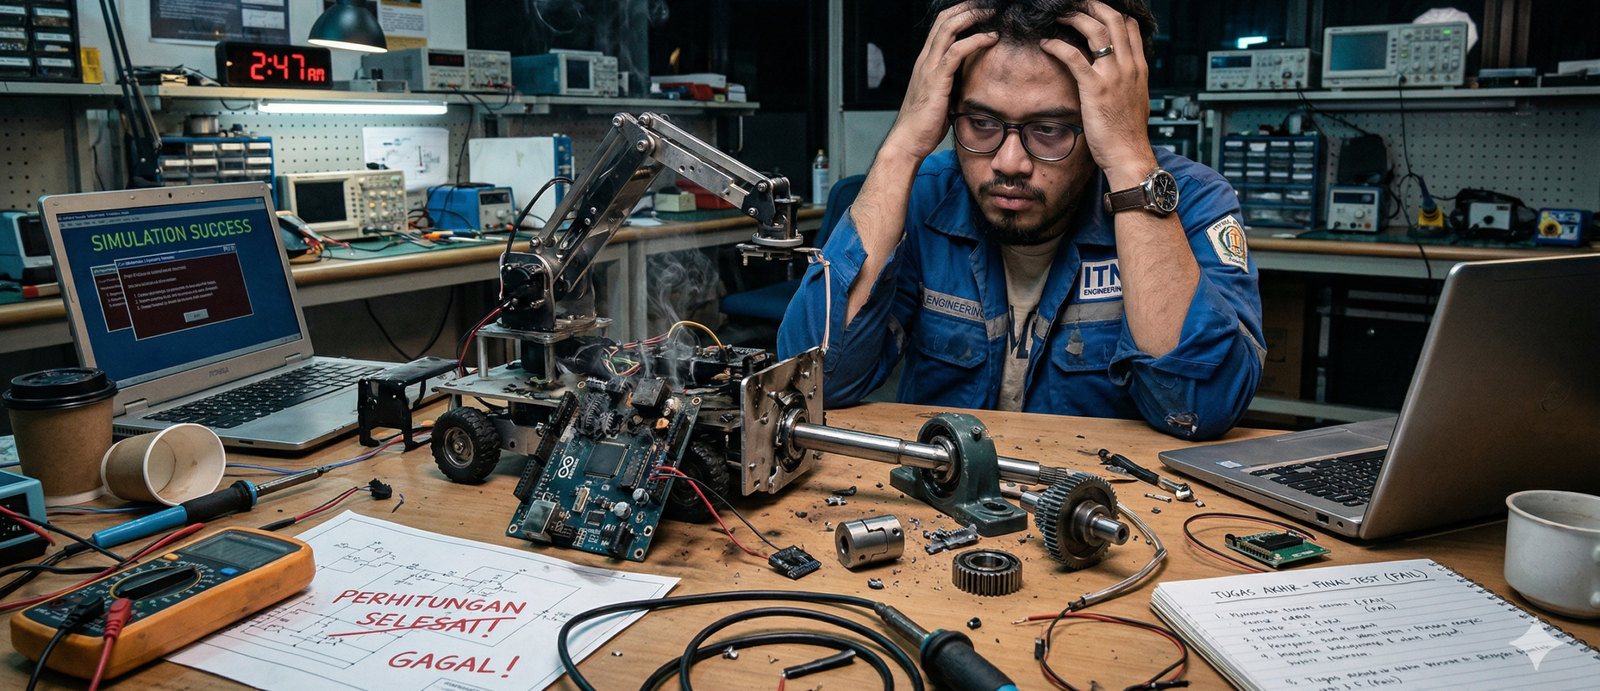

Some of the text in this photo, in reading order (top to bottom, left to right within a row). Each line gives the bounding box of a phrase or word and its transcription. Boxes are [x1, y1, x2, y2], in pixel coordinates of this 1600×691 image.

[250, 51, 325, 82] 2:47 AM
[91, 218, 252, 252] SIMULATION SUCCESS
[1083, 285, 1122, 296] ENGINEERIN
[1210, 589, 1256, 599] TUGAS
[1262, 583, 1302, 595] AKHIR
[1312, 578, 1350, 589] FINAL
[1350, 574, 1380, 585] TEST
[1383, 568, 1428, 583] (FAIL)
[332, 588, 528, 615] PERHITUNGAN
